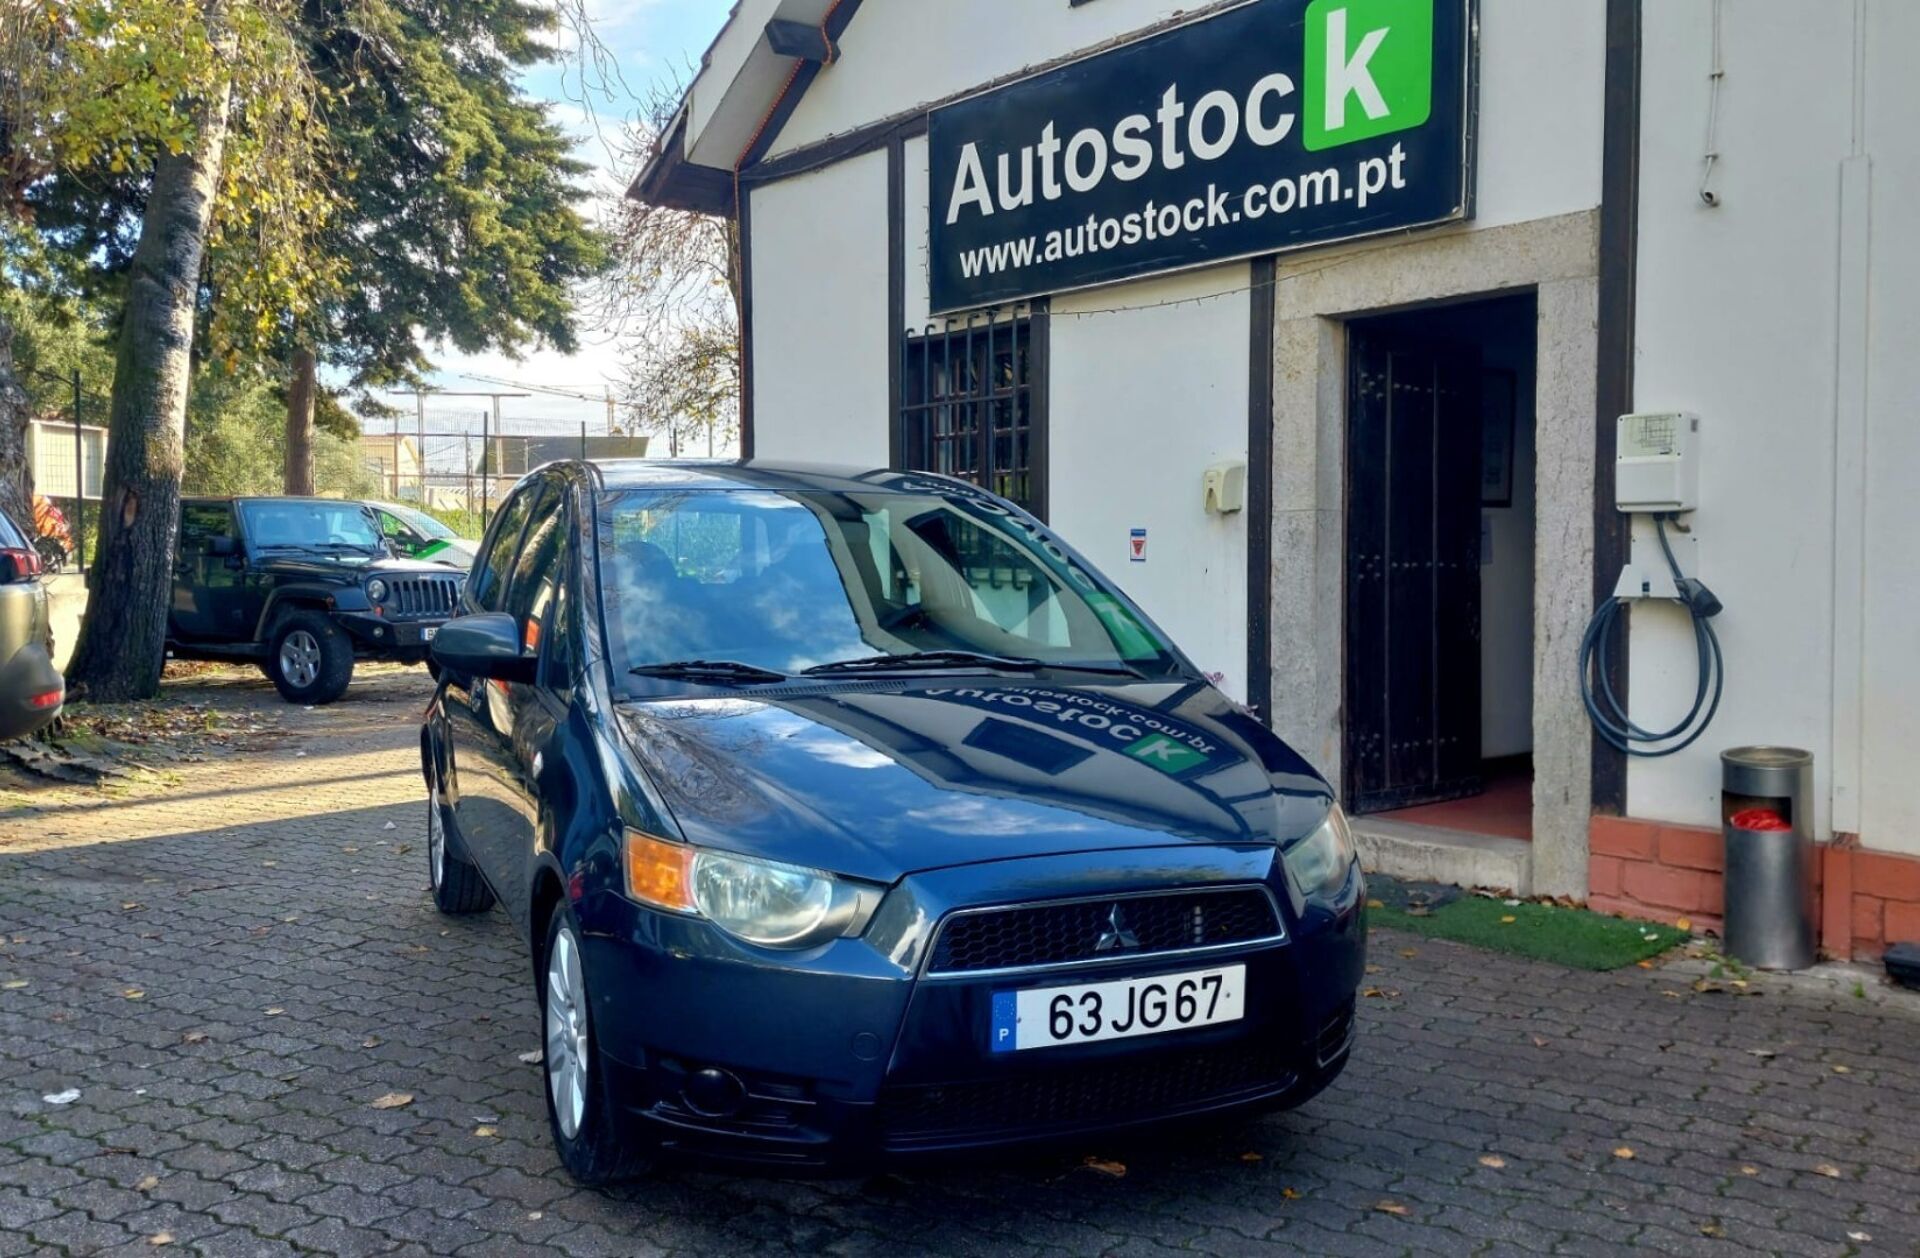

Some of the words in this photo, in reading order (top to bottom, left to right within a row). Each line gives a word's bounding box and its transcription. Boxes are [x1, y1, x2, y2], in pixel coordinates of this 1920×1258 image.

[946, 7, 1390, 225] Autostock
[959, 142, 1406, 278] www.autostock.com.pt
[999, 1028, 1009, 1041] P
[1049, 991, 1103, 1040] 63
